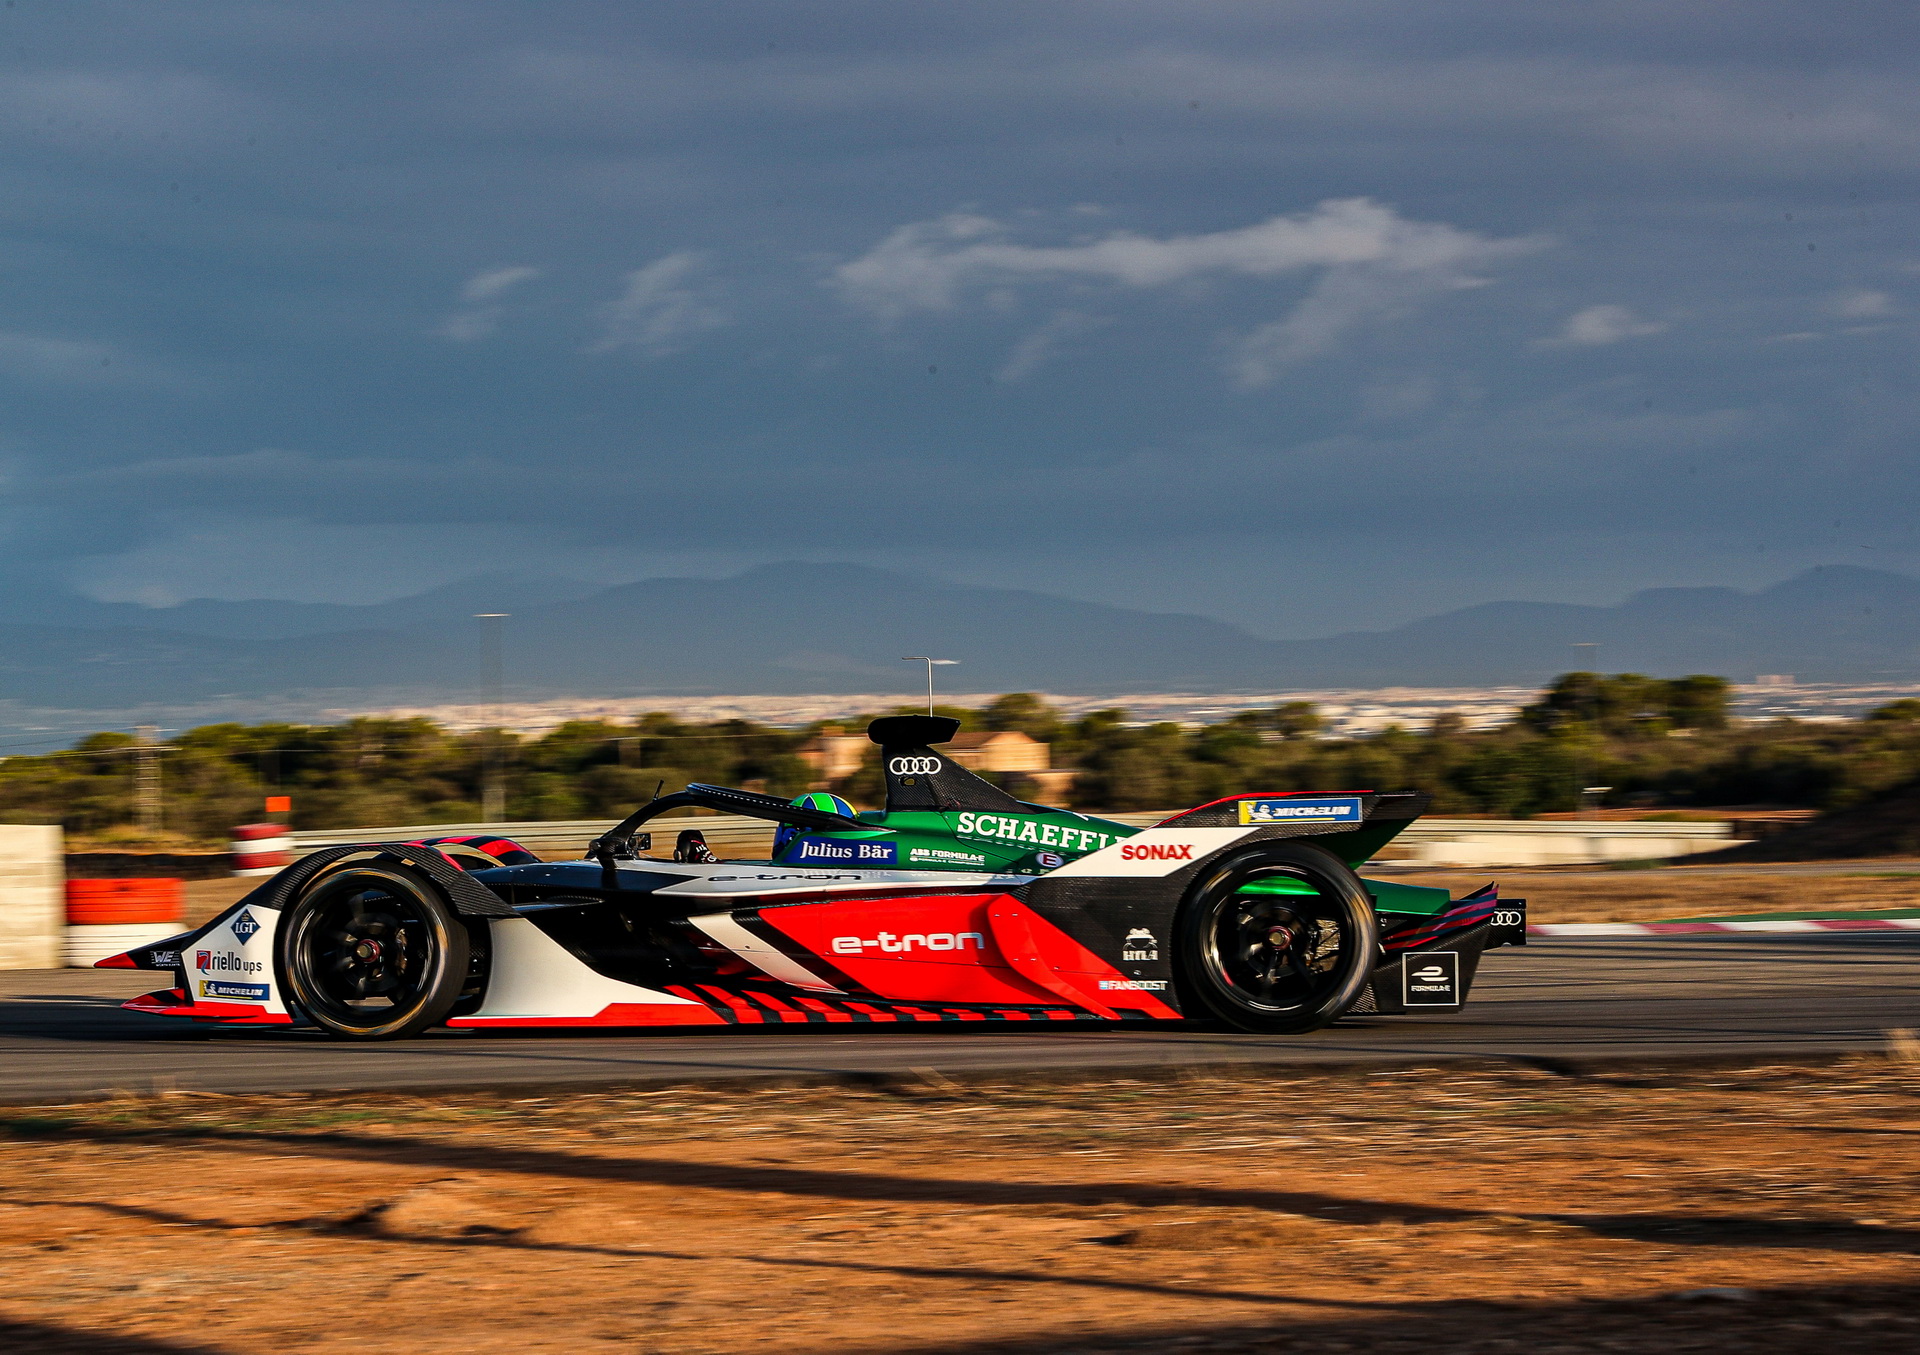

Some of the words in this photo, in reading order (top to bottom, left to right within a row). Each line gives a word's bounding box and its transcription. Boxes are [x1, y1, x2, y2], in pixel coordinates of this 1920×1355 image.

[1273, 806, 1351, 816] MICHELIN
[957, 812, 1128, 851] SCHAEFFL
[800, 841, 852, 858] Julius
[857, 844, 892, 859] Bär
[1121, 844, 1192, 860] SONAX
[1042, 854, 1057, 866] E
[235, 922, 256, 934] LGT
[831, 931, 985, 954] e-tron
[212, 951, 241, 971] riello
[243, 961, 262, 975] ups
[217, 986, 264, 996] MICHELIN
